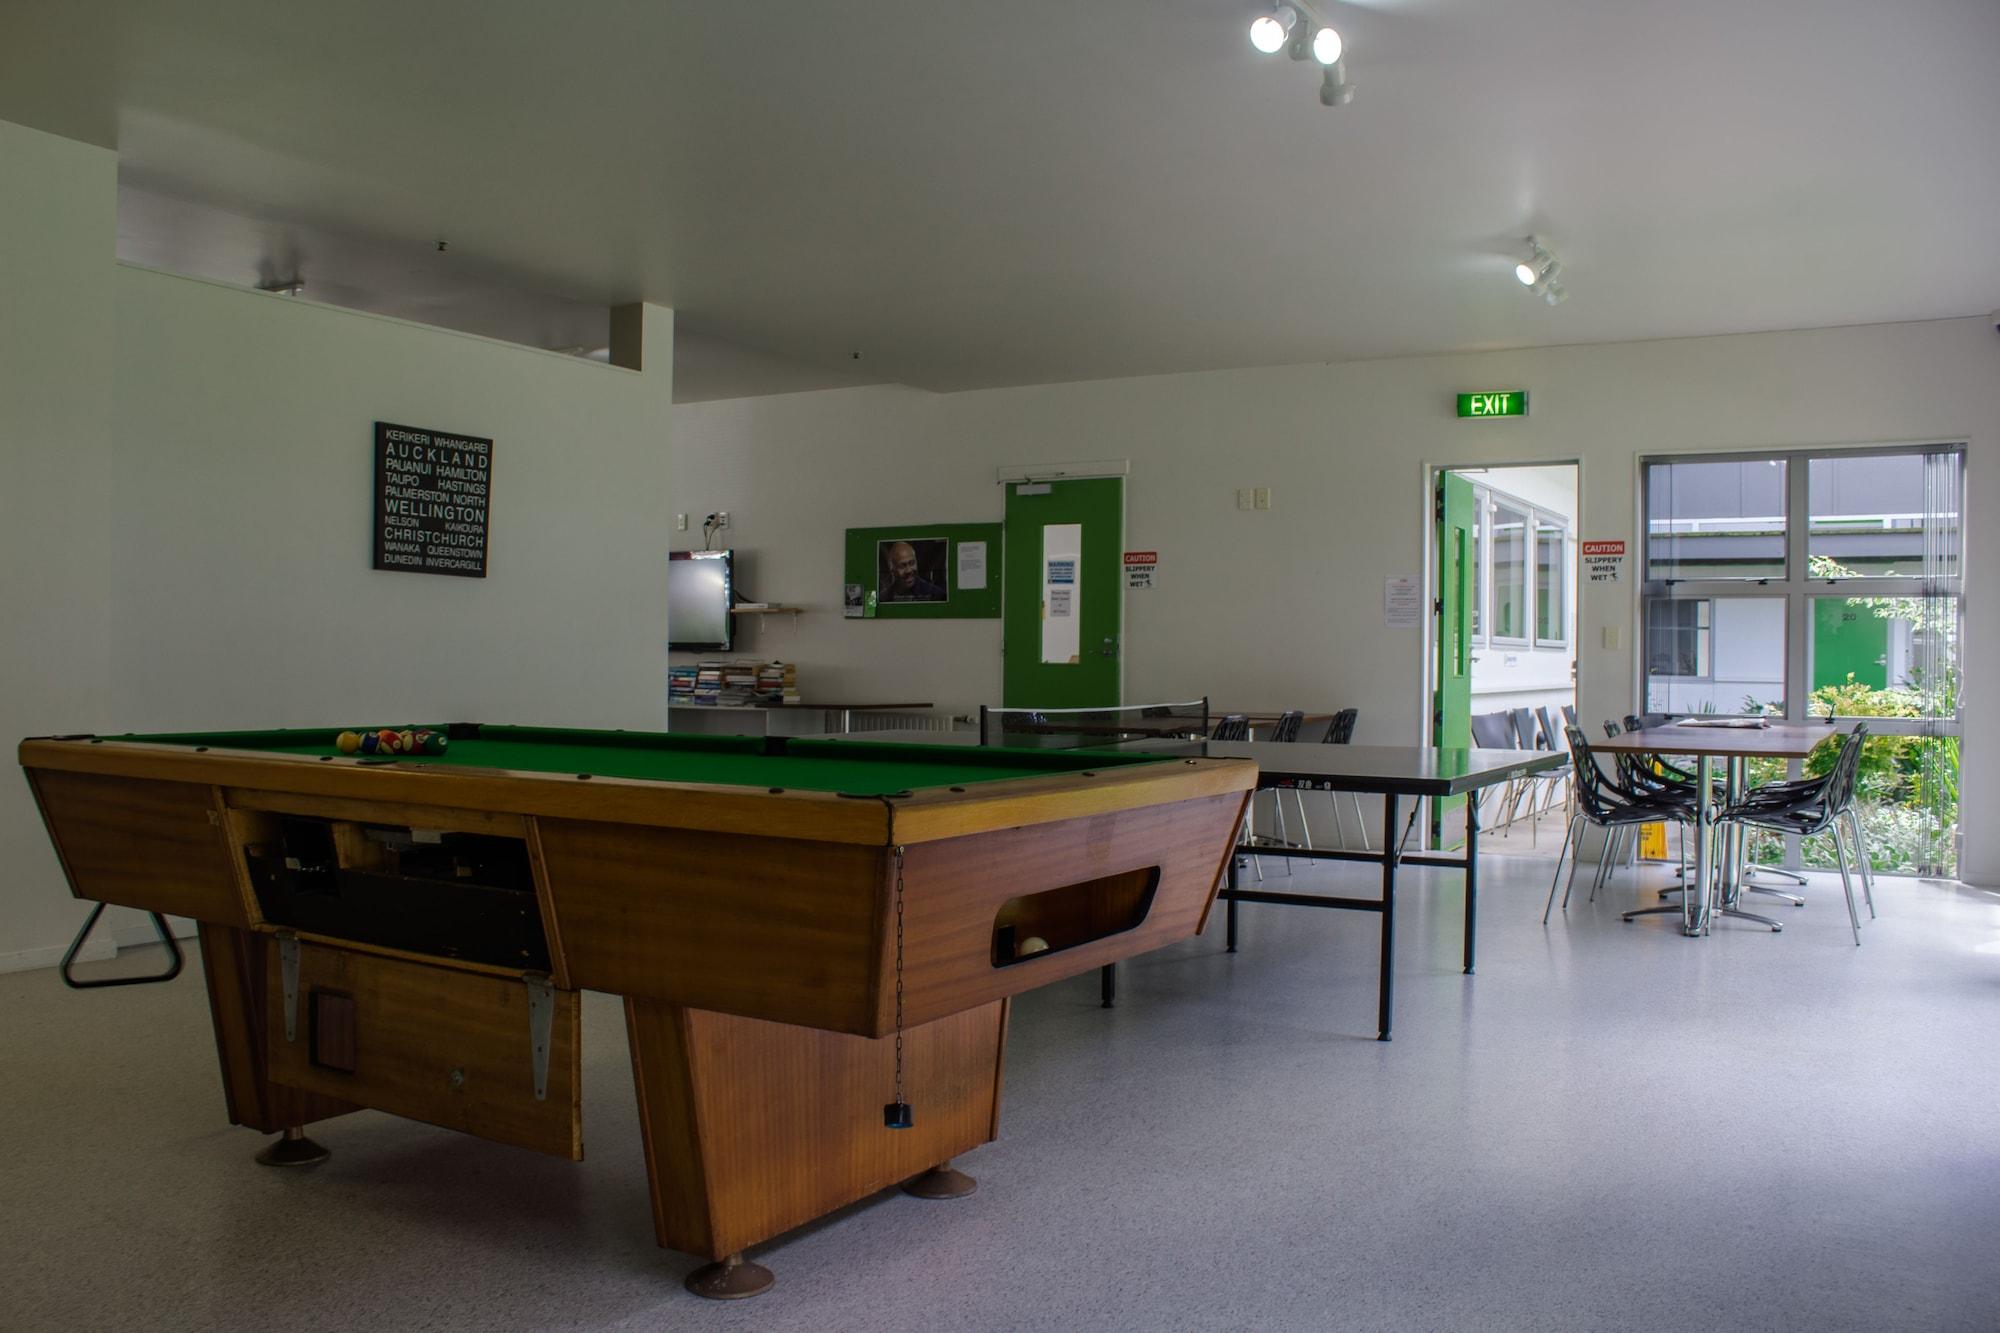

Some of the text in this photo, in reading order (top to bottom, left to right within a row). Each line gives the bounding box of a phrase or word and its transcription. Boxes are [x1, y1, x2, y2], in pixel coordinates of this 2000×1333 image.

[1471, 394, 1510, 415] EXIT
[386, 430, 488, 453] KERIKERI WHANGAREI
[386, 443, 487, 468] AUCKLAND
[386, 459, 486, 482] PAUANUI HAMILTON
[386, 472, 486, 494] TAUPO HASTINGS
[386, 486, 486, 507] PALMERSTON NORTH
[385, 499, 484, 523] WELLINGTON
[385, 516, 483, 534] NELSON KAIKOURA
[385, 527, 483, 547] CHRISTCHURCH
[384, 542, 483, 559] WANAKA QUEENSTOWN
[1585, 544, 1623, 553] CAUTION
[384, 554, 482, 570] DUNEDIN INVERCARGILL
